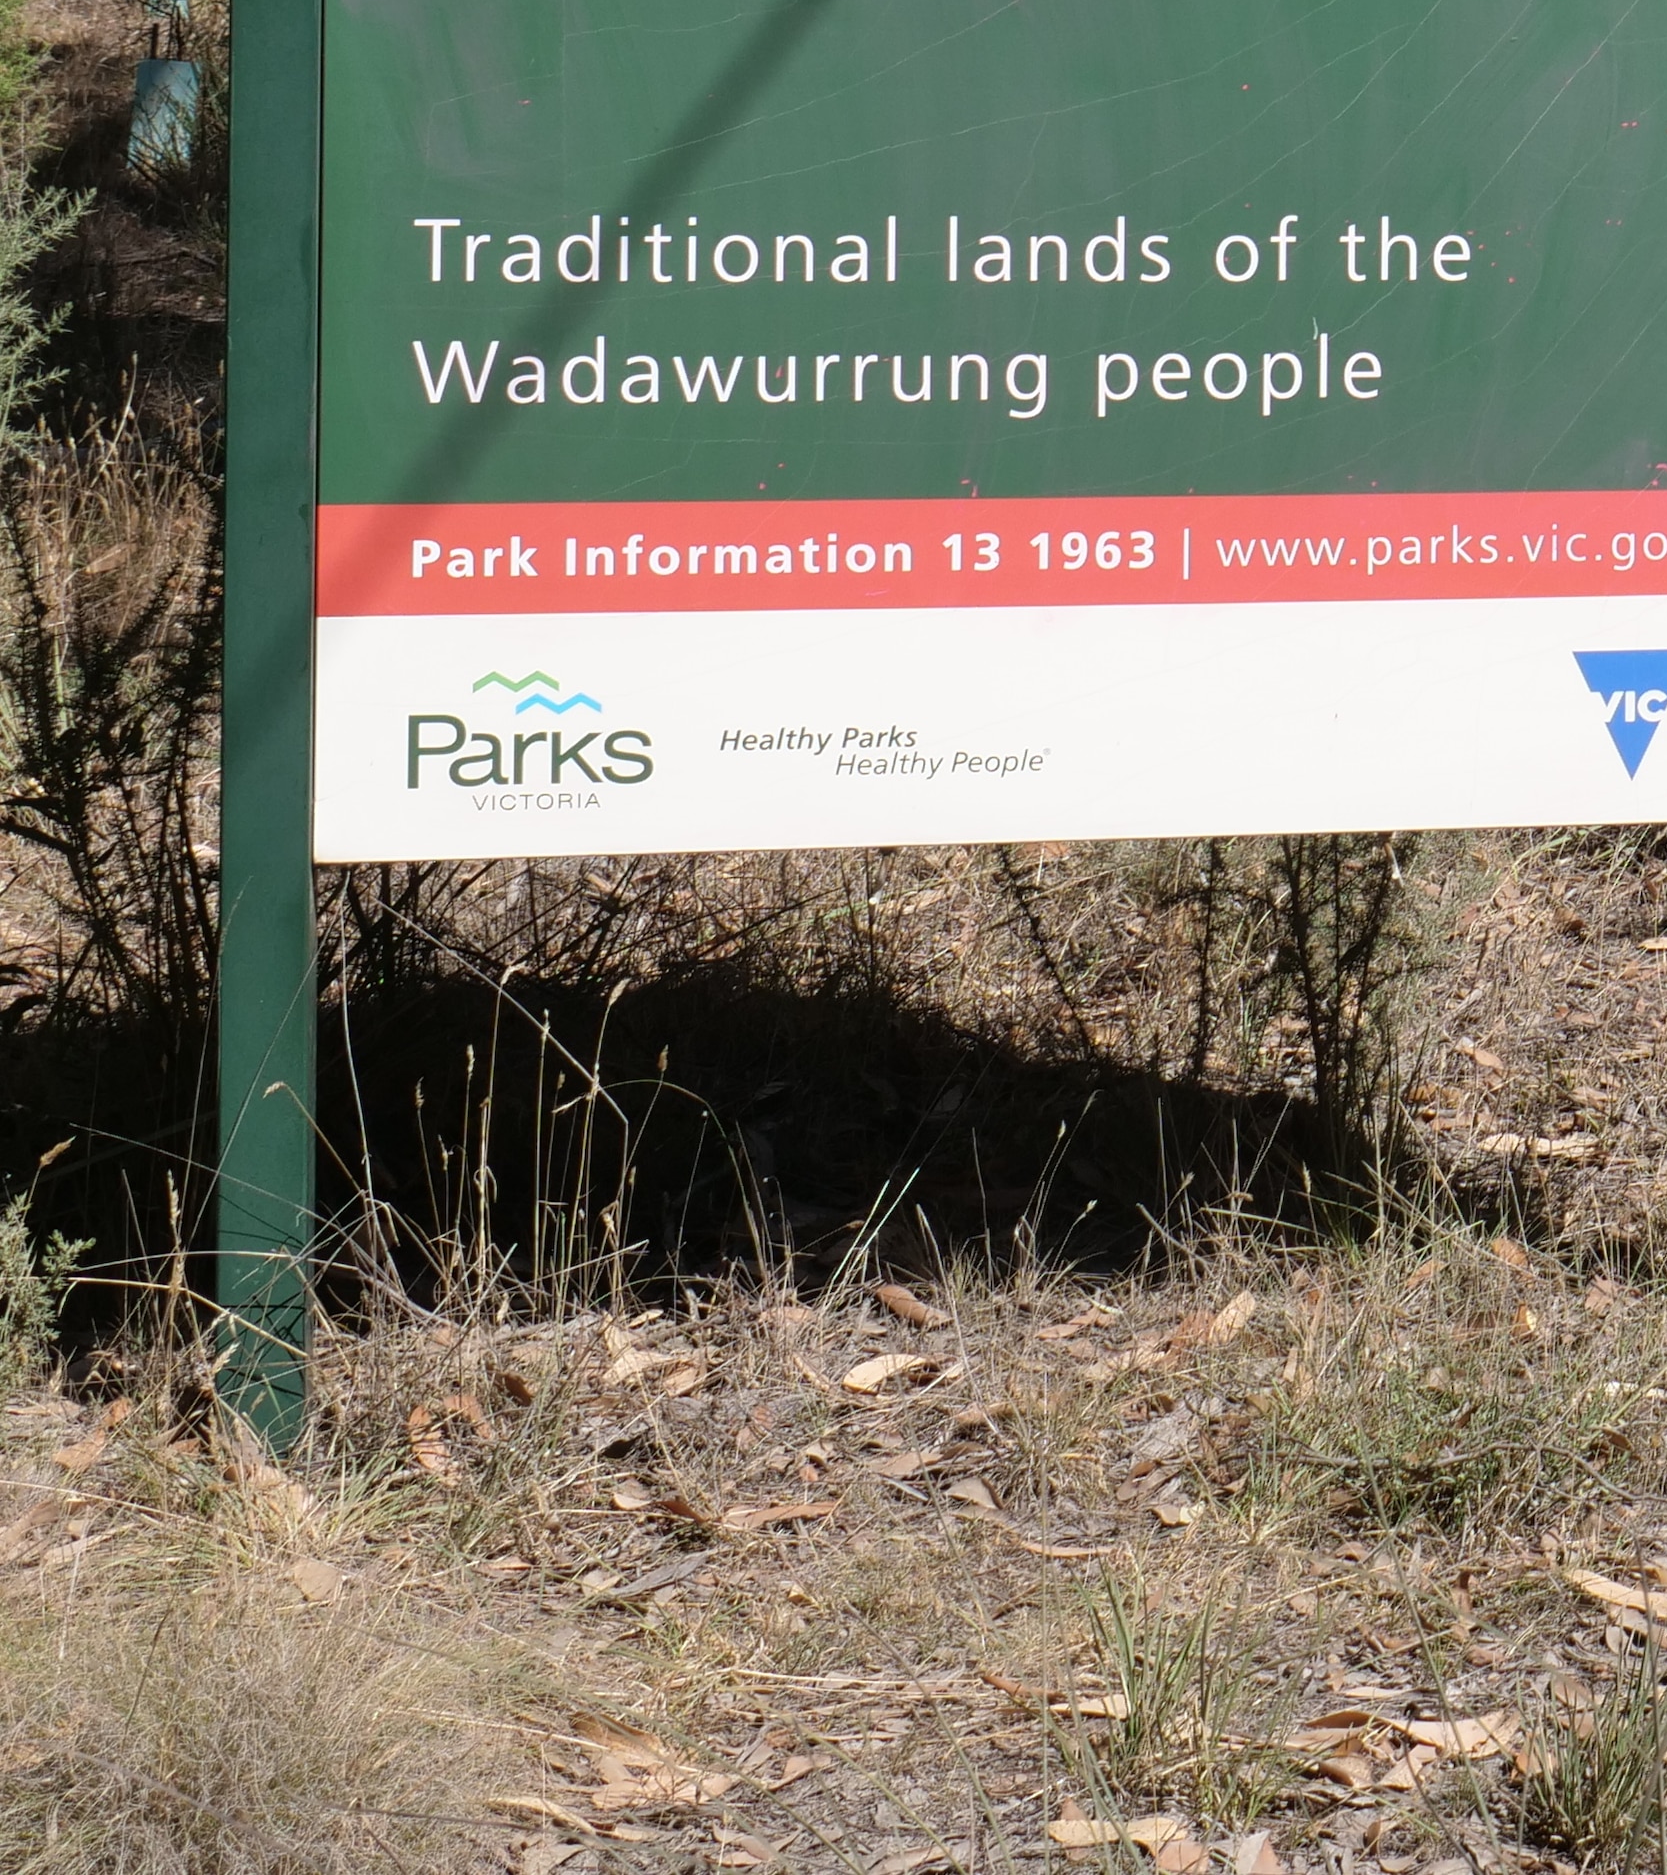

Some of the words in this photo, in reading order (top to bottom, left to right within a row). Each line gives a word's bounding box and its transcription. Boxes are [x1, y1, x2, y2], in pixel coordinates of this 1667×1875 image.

[413, 214, 897, 283] Traditional
[948, 215, 1171, 283] lands
[1215, 214, 1299, 283] of
[1338, 215, 1472, 283] the
[411, 335, 1048, 420] Wadawurrung
[1097, 333, 1383, 418] people
[411, 535, 539, 579] Park
[565, 532, 912, 577] Information
[942, 532, 1001, 572] 13
[1029, 530, 1155, 571] 1963
[407, 714, 654, 789] Parks
[720, 727, 832, 756] Healthy
[842, 725, 917, 748] Parks
[835, 749, 943, 779] Healthy
[472, 793, 601, 811] VICTORIA
